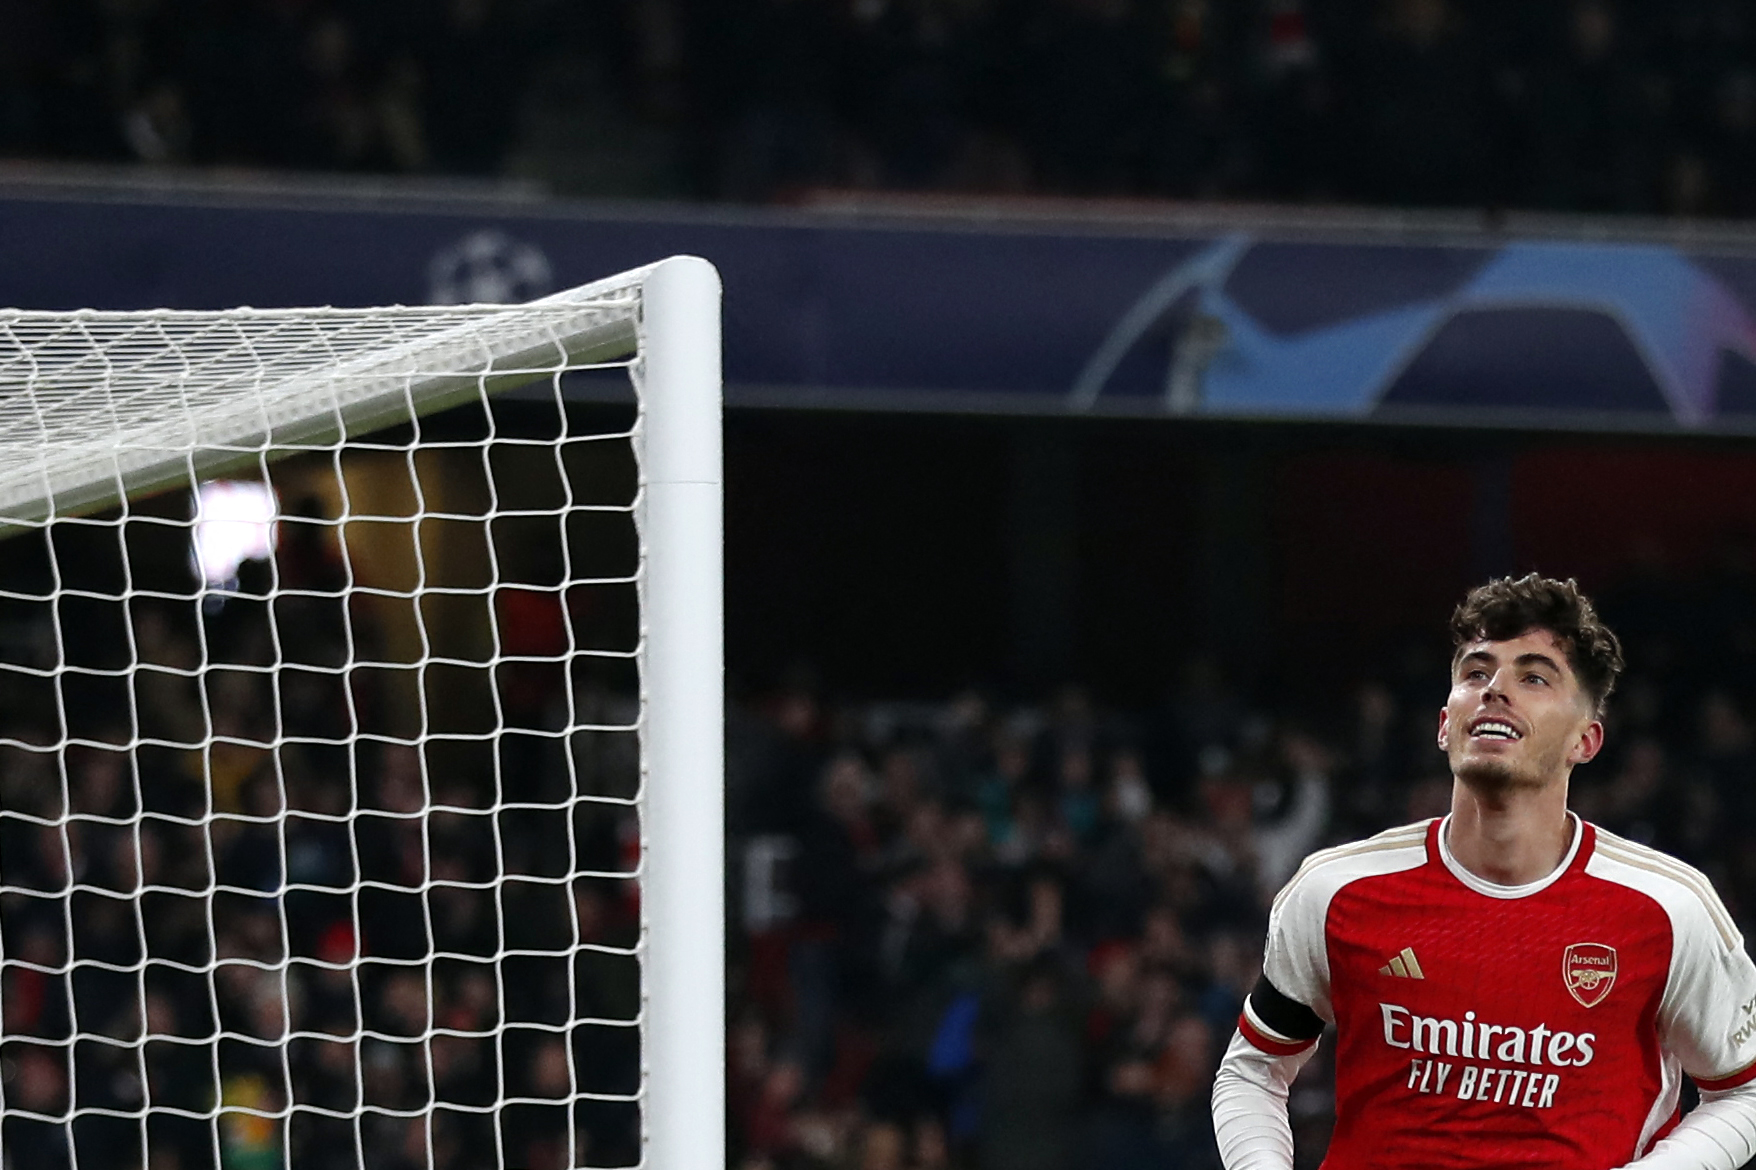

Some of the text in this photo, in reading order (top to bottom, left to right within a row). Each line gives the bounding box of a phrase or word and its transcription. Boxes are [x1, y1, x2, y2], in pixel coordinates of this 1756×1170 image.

[1571, 954, 1610, 966] Arsenal
[1379, 1002, 1596, 1067] Emirates
[1407, 1058, 1560, 1108] FLY BETTER
